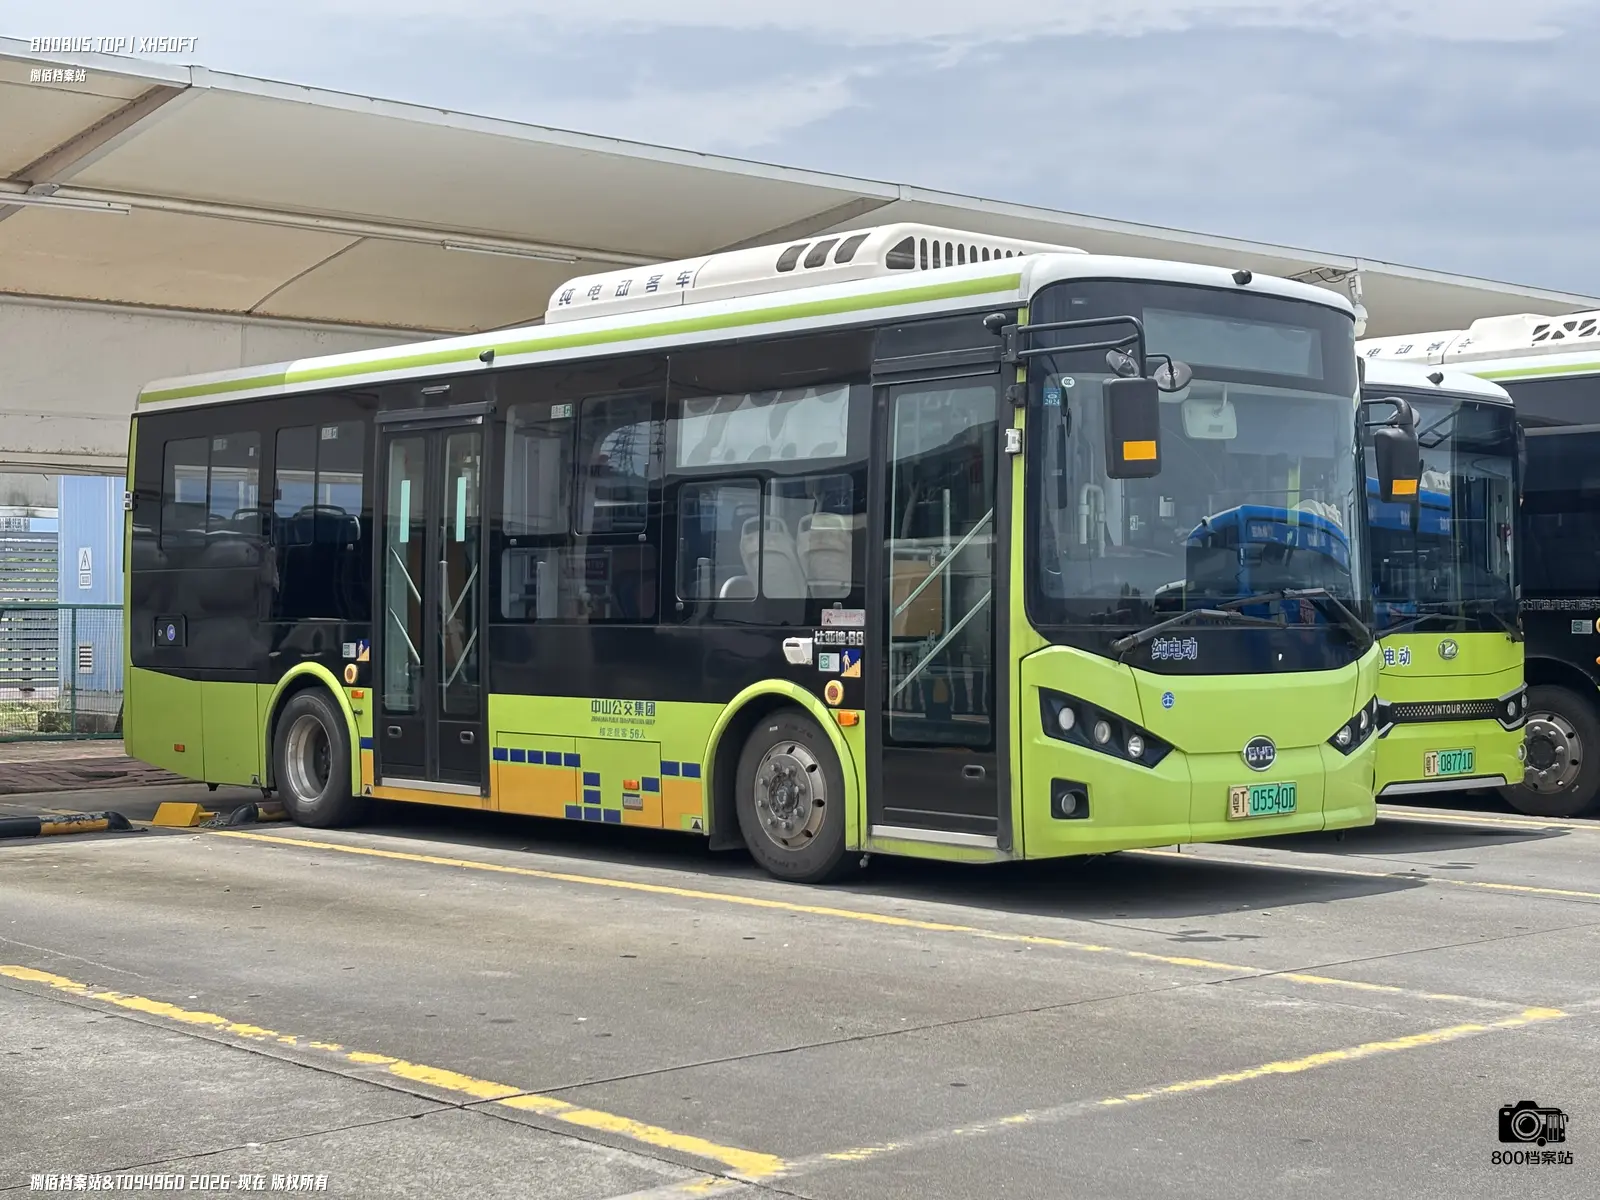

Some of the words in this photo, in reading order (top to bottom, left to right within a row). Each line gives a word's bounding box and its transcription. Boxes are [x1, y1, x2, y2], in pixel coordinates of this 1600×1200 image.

[558, 270, 694, 306] 纯电动客车
[1151, 637, 1198, 660] 纯电动
[591, 699, 656, 717] 中山公交集团
[1434, 704, 1462, 715] INTOUR
[1247, 745, 1274, 761] BYD
